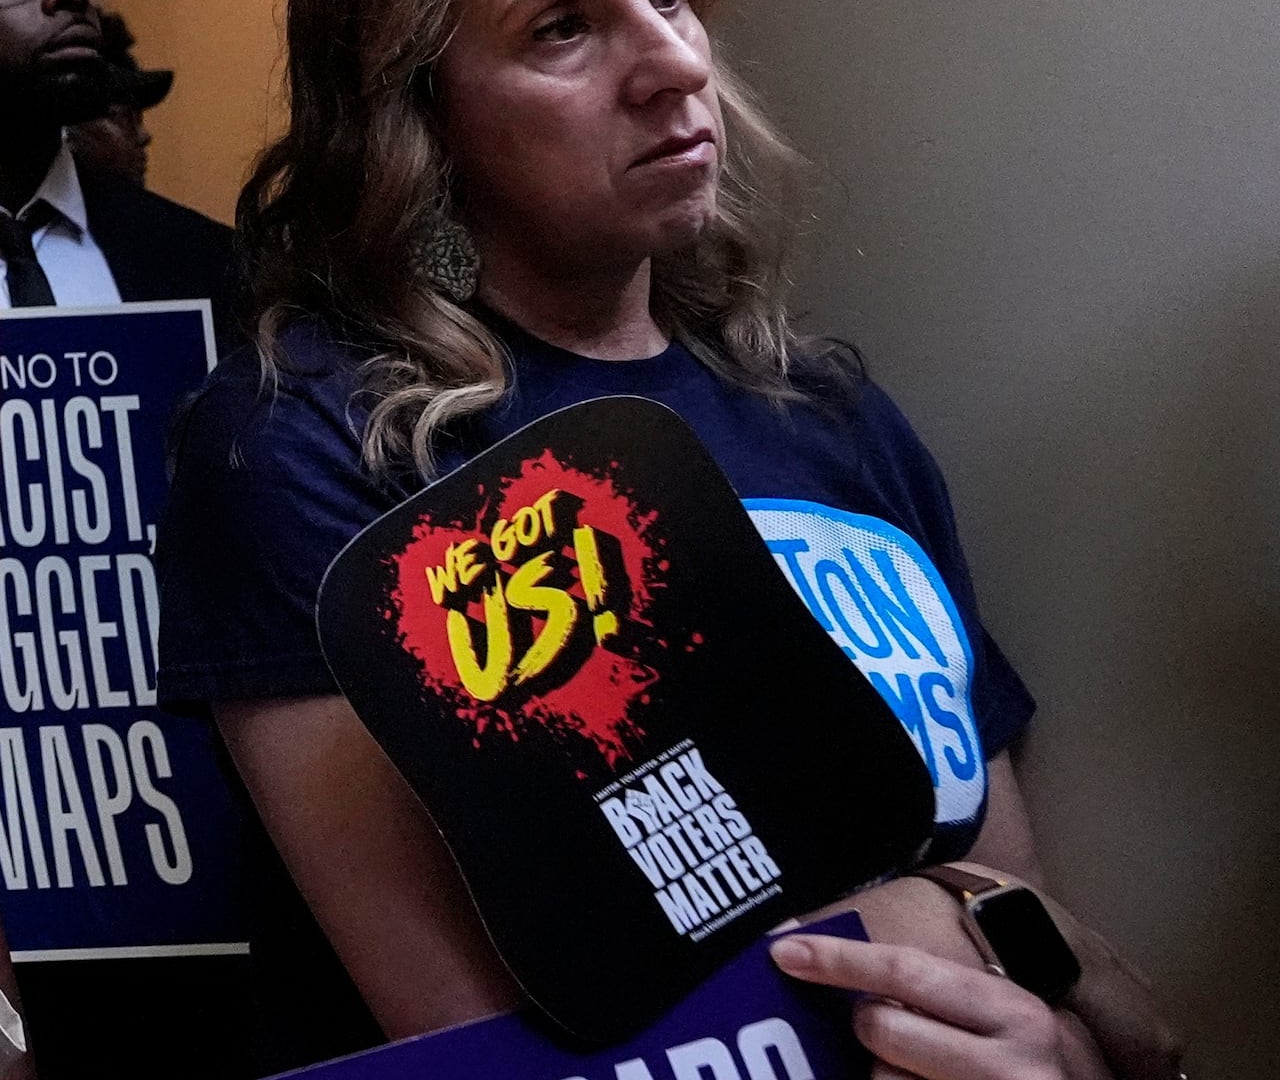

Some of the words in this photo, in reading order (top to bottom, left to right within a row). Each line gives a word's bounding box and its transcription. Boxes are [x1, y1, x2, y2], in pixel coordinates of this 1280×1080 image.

[0, 352, 57, 391] NO
[63, 350, 119, 387] TO
[425, 538, 488, 606] WE
[490, 487, 561, 562] GOT
[446, 523, 620, 703] US!
[627, 792, 754, 890] VOTERS
[653, 834, 783, 937] MATTER
